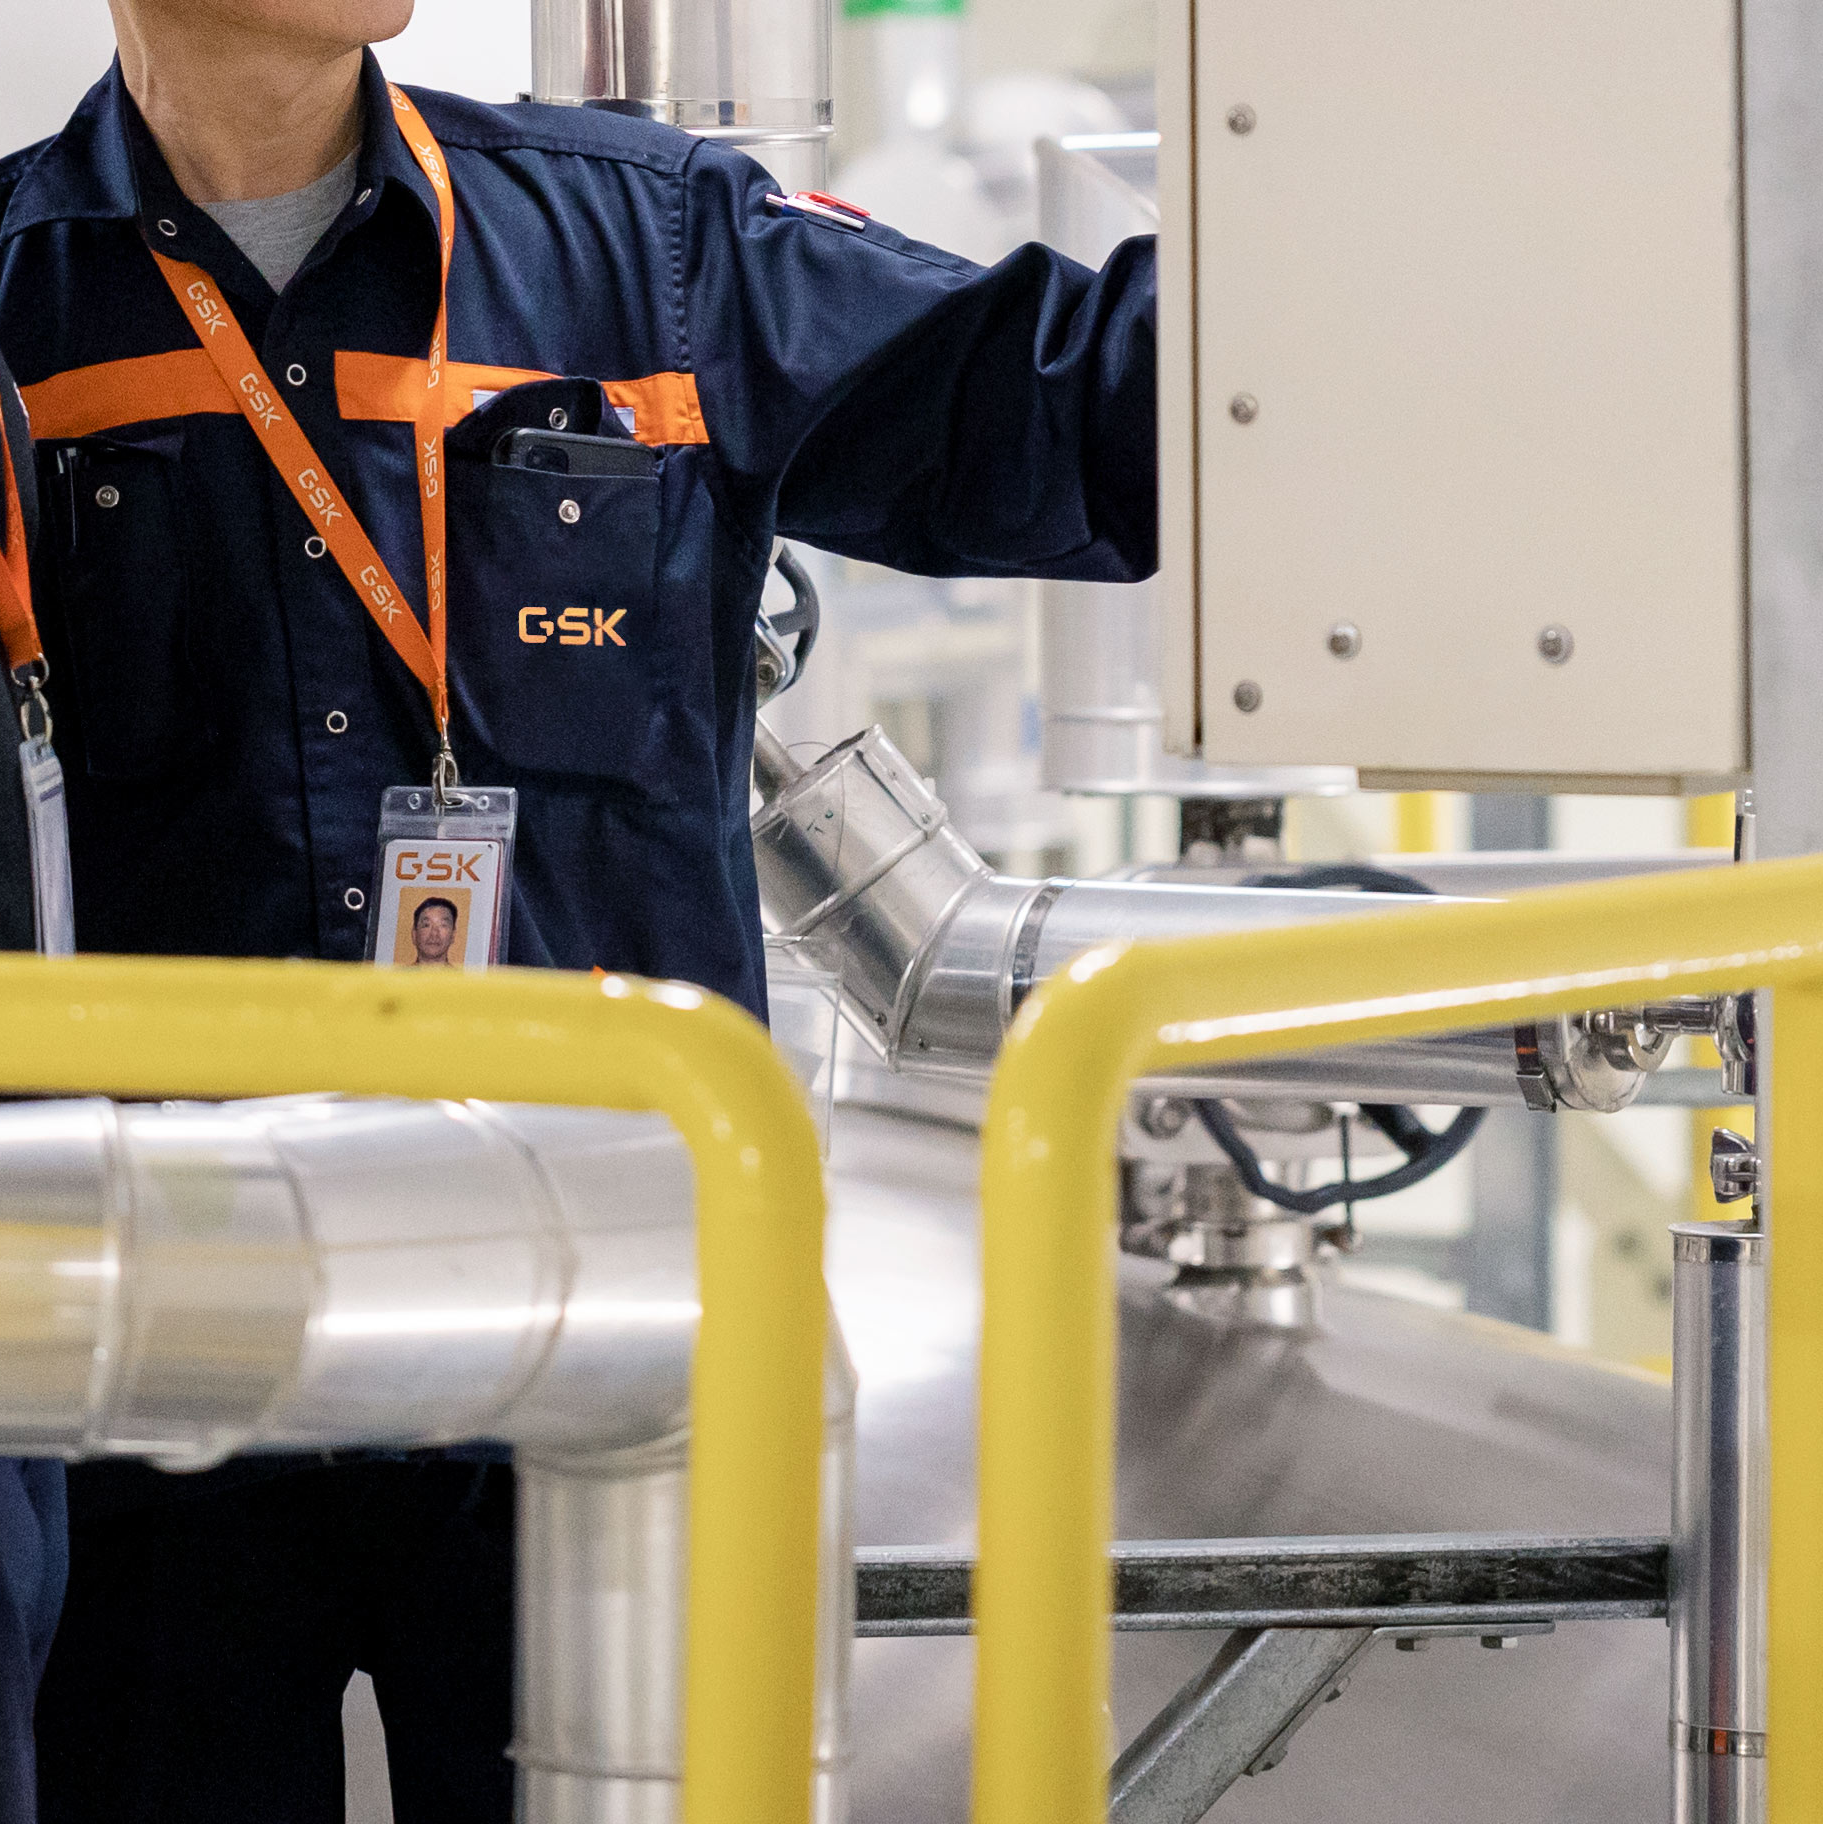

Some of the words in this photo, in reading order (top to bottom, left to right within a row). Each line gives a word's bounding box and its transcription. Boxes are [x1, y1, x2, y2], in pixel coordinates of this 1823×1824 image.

[415, 142, 446, 189] GSK
[187, 281, 228, 336] GSK
[427, 330, 441, 389] GSK
[239, 372, 282, 430] GSK
[423, 436, 438, 498] GSK
[297, 468, 343, 526] GSK
[360, 565, 402, 624] GSK
[430, 548, 441, 612] GSK
[518, 606, 628, 647] GSK
[395, 851, 483, 882] GSK
